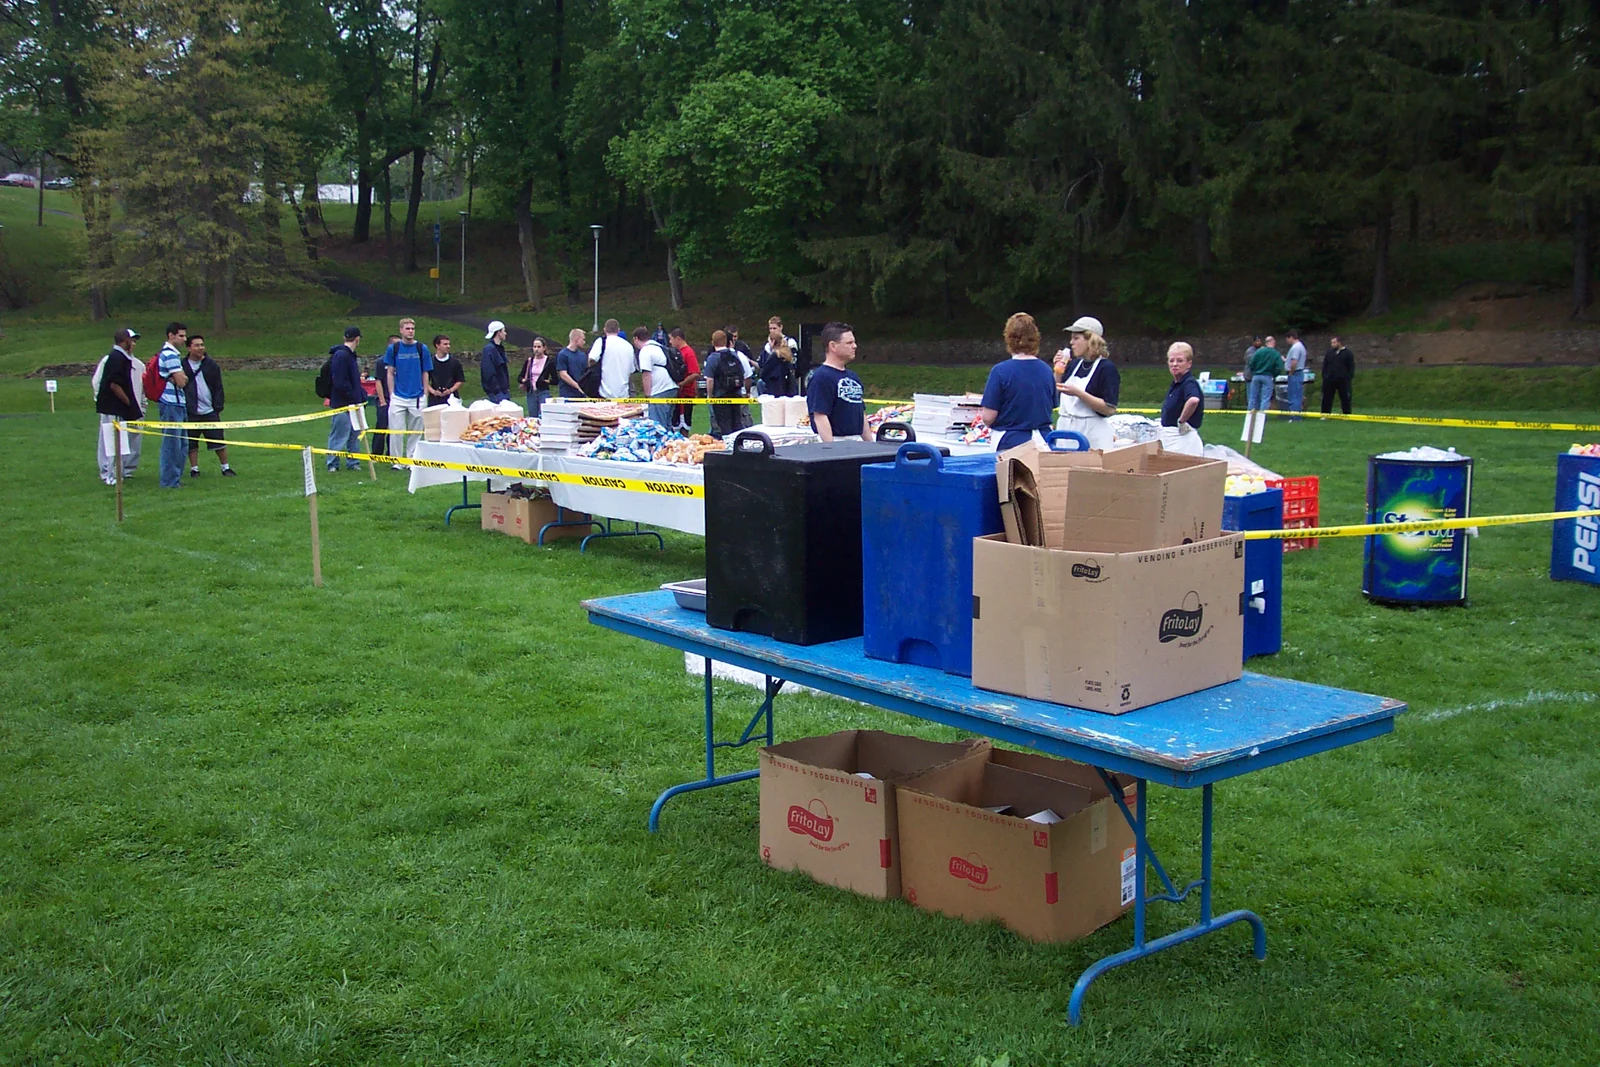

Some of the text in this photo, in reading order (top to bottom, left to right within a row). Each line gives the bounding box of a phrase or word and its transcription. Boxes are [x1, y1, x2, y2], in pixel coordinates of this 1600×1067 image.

[412, 459, 448, 469] CAUTION
[465, 465, 504, 476] CAUTION
[518, 470, 560, 482] CAUTION
[581, 475, 627, 490] CAUTION
[644, 481, 694, 496] CAUTION
[1572, 471, 1600, 574] PEPSI
[1138, 551, 1176, 564] VENDING
[1188, 537, 1233, 555] FOODSERVICE
[1162, 613, 1201, 633] FritoLay
[768, 758, 799, 773] VENDING
[810, 770, 865, 788] FOODSERVICE
[790, 809, 831, 840] FritoLay
[913, 797, 951, 812] VENDING
[965, 809, 1029, 830] FOODSERVICE
[950, 860, 986, 882] FritoLay
